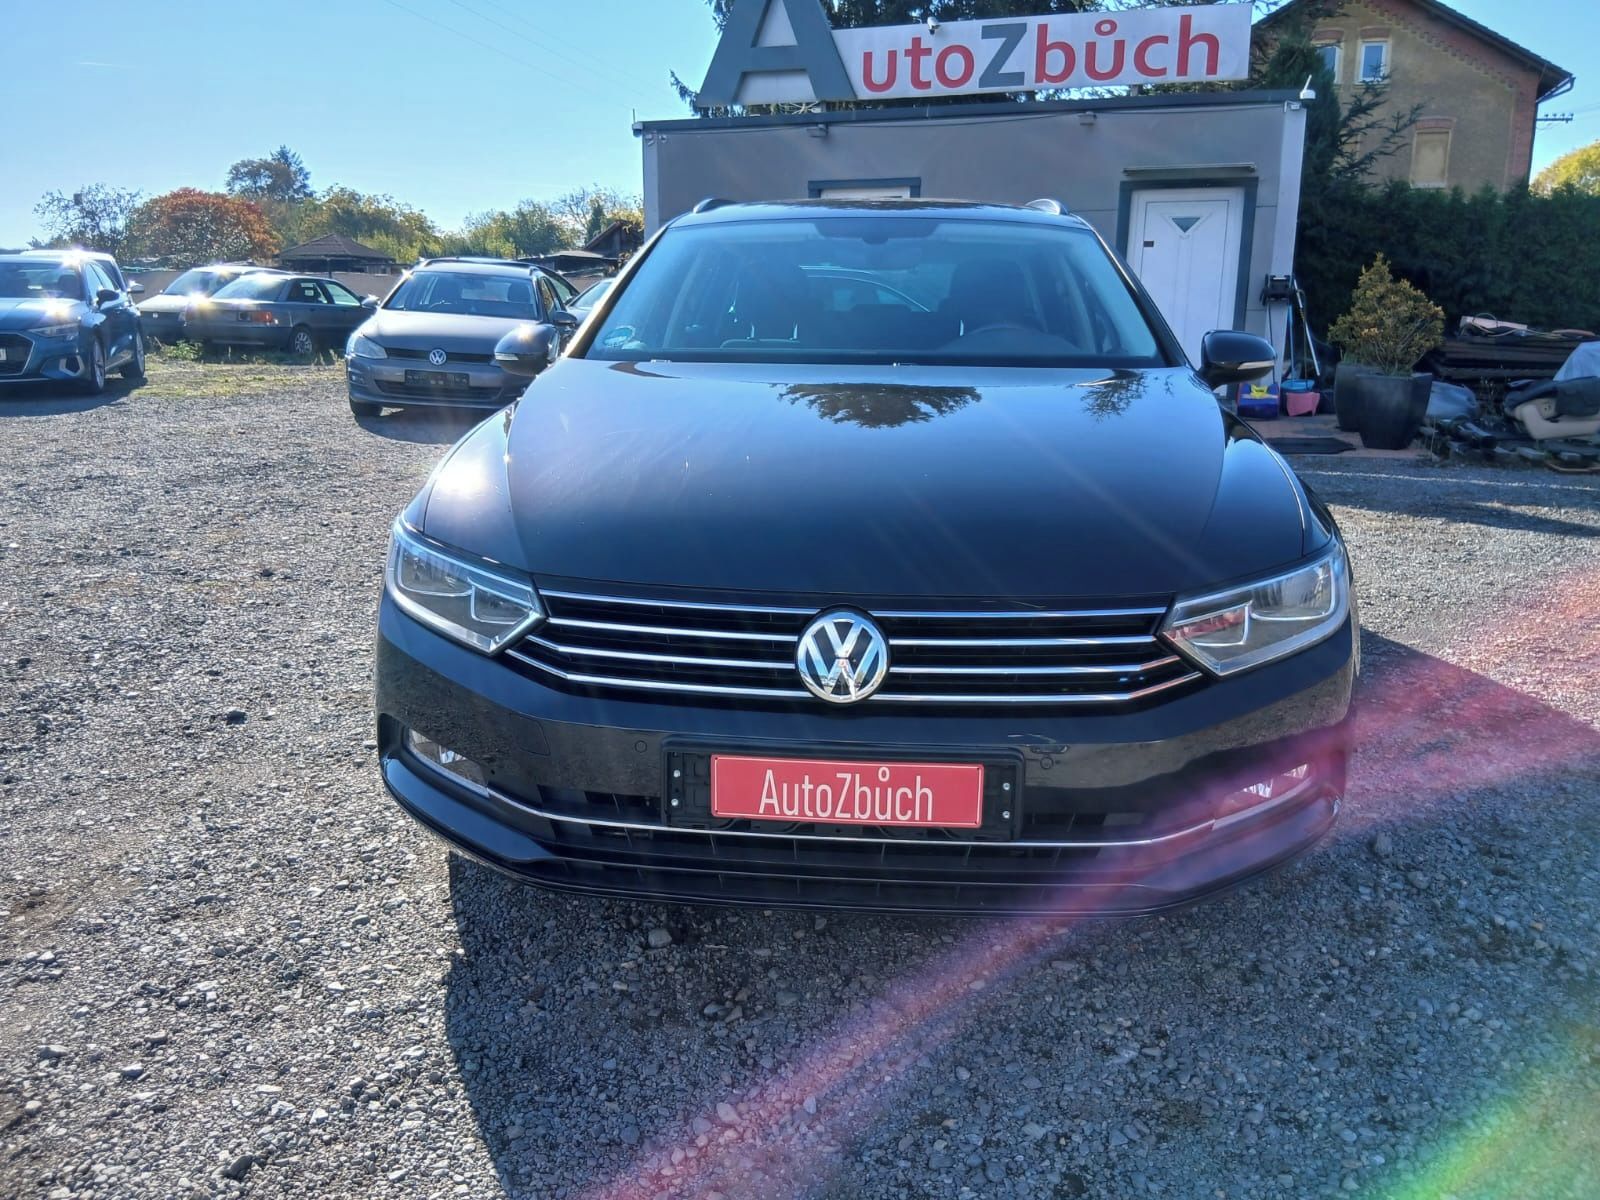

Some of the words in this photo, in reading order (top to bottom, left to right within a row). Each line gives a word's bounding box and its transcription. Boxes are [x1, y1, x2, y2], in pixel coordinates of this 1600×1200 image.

[698, 0, 1220, 107] AutoZbůch
[796, 611, 889, 704] VW
[758, 766, 933, 822] AutoZbůch
